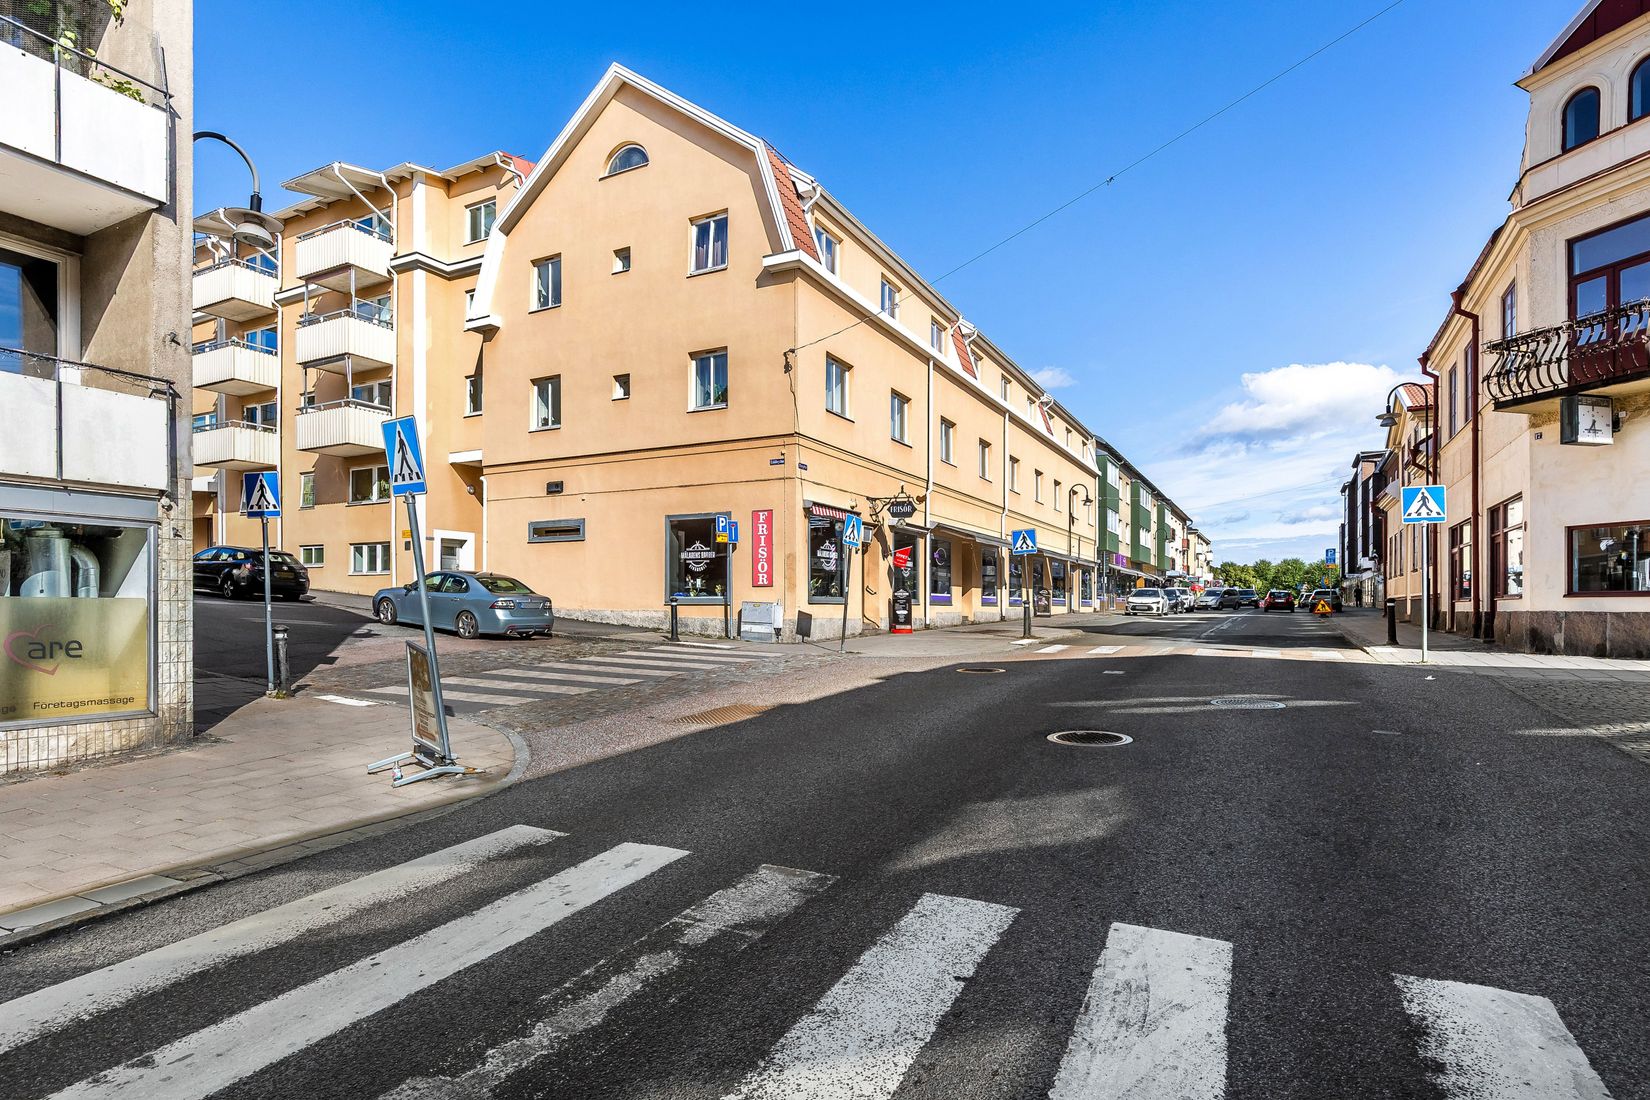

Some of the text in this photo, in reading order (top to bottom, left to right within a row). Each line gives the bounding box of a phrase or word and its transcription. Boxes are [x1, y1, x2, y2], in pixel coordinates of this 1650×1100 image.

[719, 517, 726, 532] P
[757, 512, 769, 585] FRISÖR
[33, 695, 135, 710] Företagsmassage
